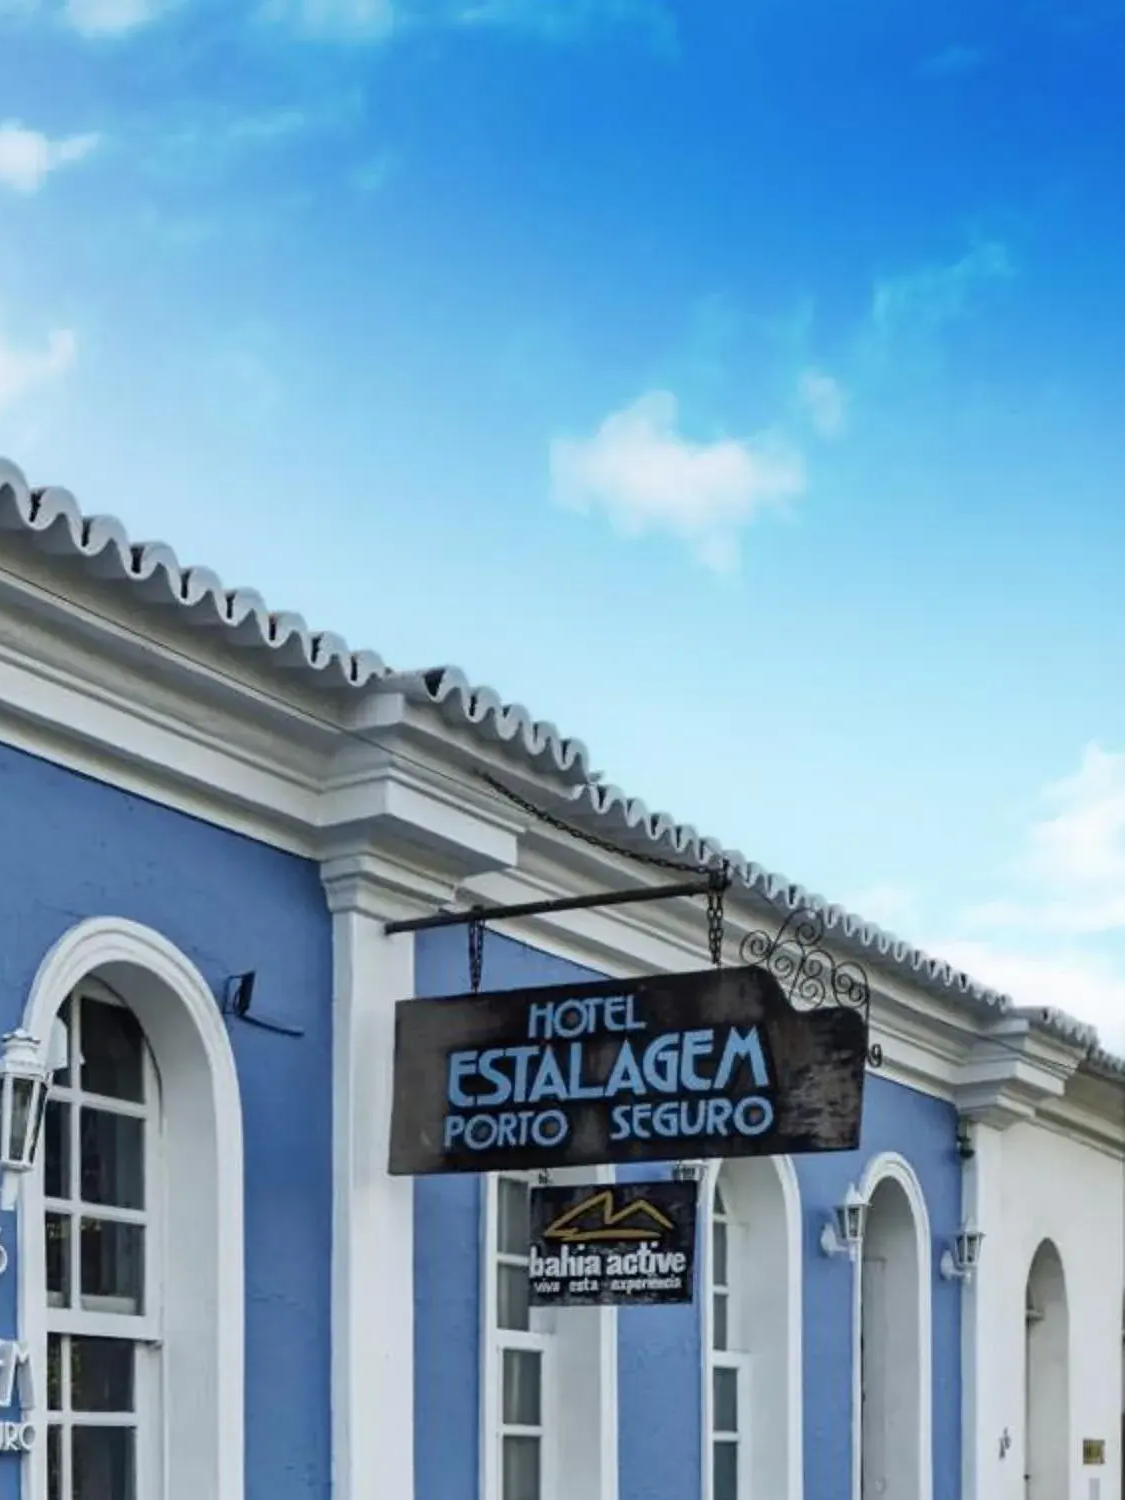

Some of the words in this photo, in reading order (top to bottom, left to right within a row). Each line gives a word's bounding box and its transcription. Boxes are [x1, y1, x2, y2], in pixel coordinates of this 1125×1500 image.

[528, 995, 646, 1039] HOTEL
[448, 1027, 769, 1107] ESTALAGEM
[444, 1110, 567, 1149] PORTO
[611, 1097, 773, 1140] SEGURO
[529, 1243, 602, 1278] bahia
[606, 1241, 687, 1276] active
[533, 1280, 561, 1293] viva
[568, 1277, 599, 1292] esta
